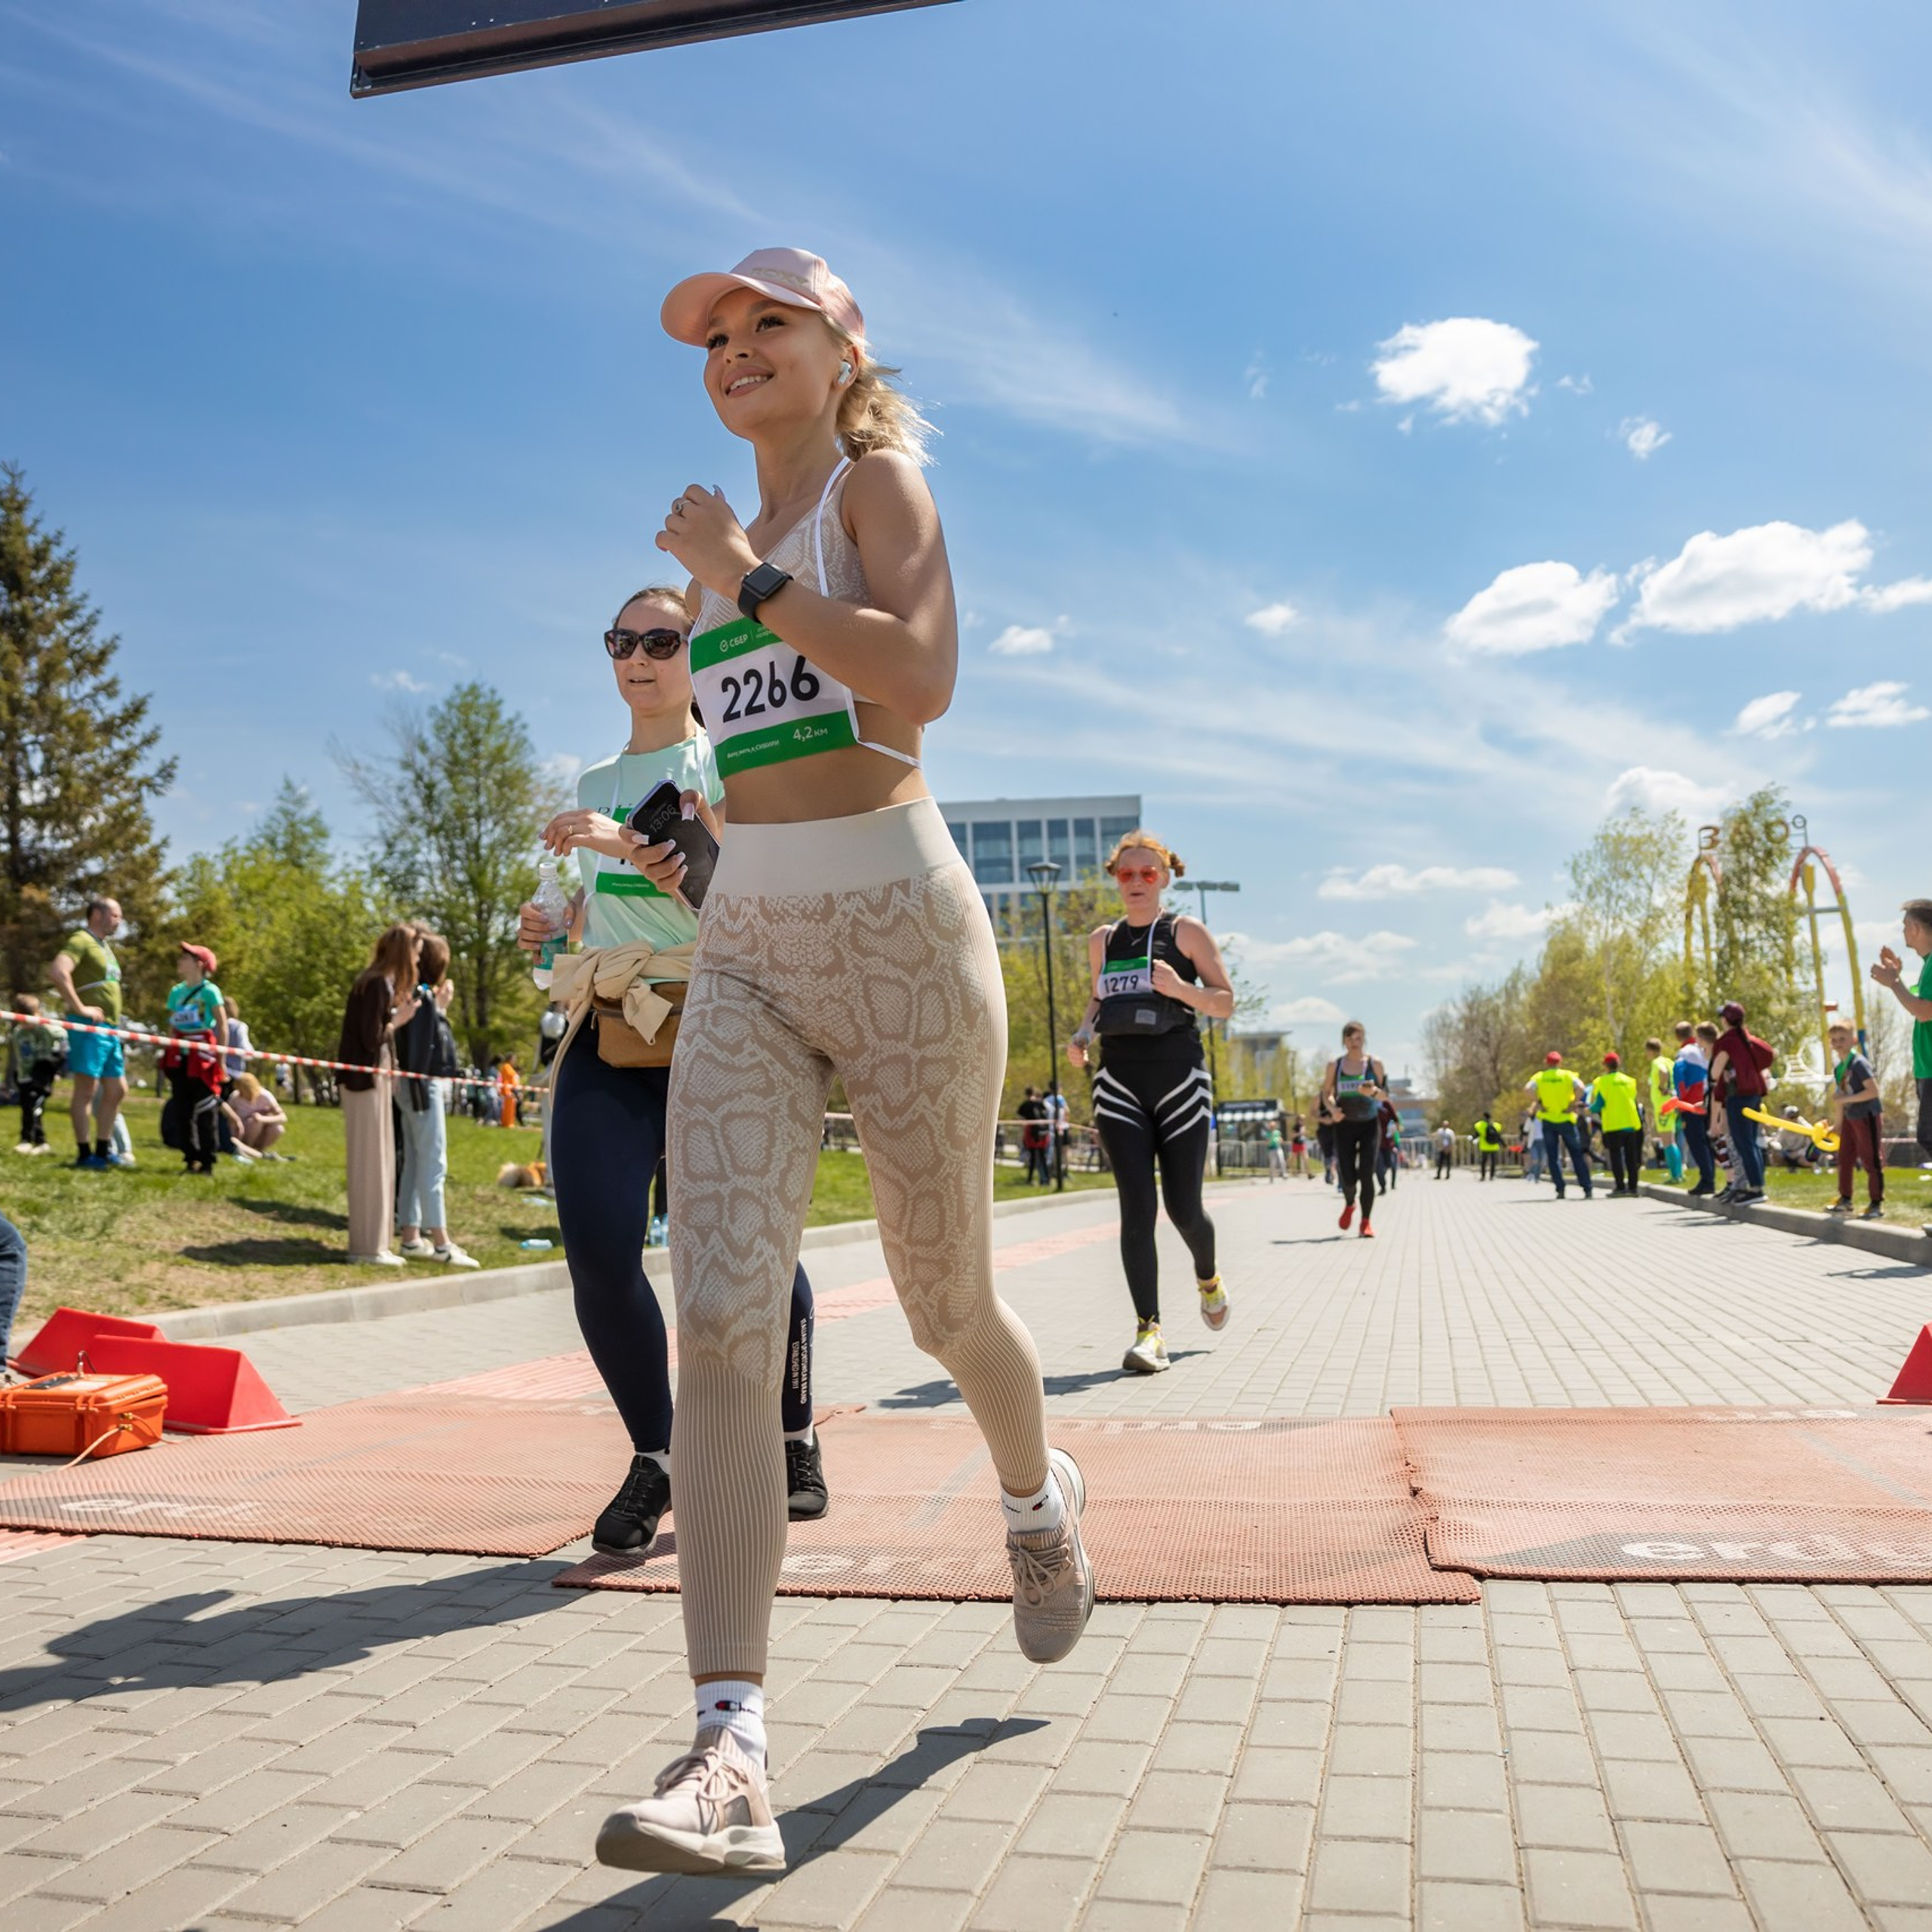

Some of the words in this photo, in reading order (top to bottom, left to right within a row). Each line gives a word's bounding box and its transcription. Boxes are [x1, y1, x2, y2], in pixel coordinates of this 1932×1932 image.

[729, 633, 748, 647] СБЕР
[721, 655, 820, 723] 2266
[792, 726, 814, 742] 4,2
[649, 804, 676, 832] 13:06
[1104, 975, 1139, 993] 1279
